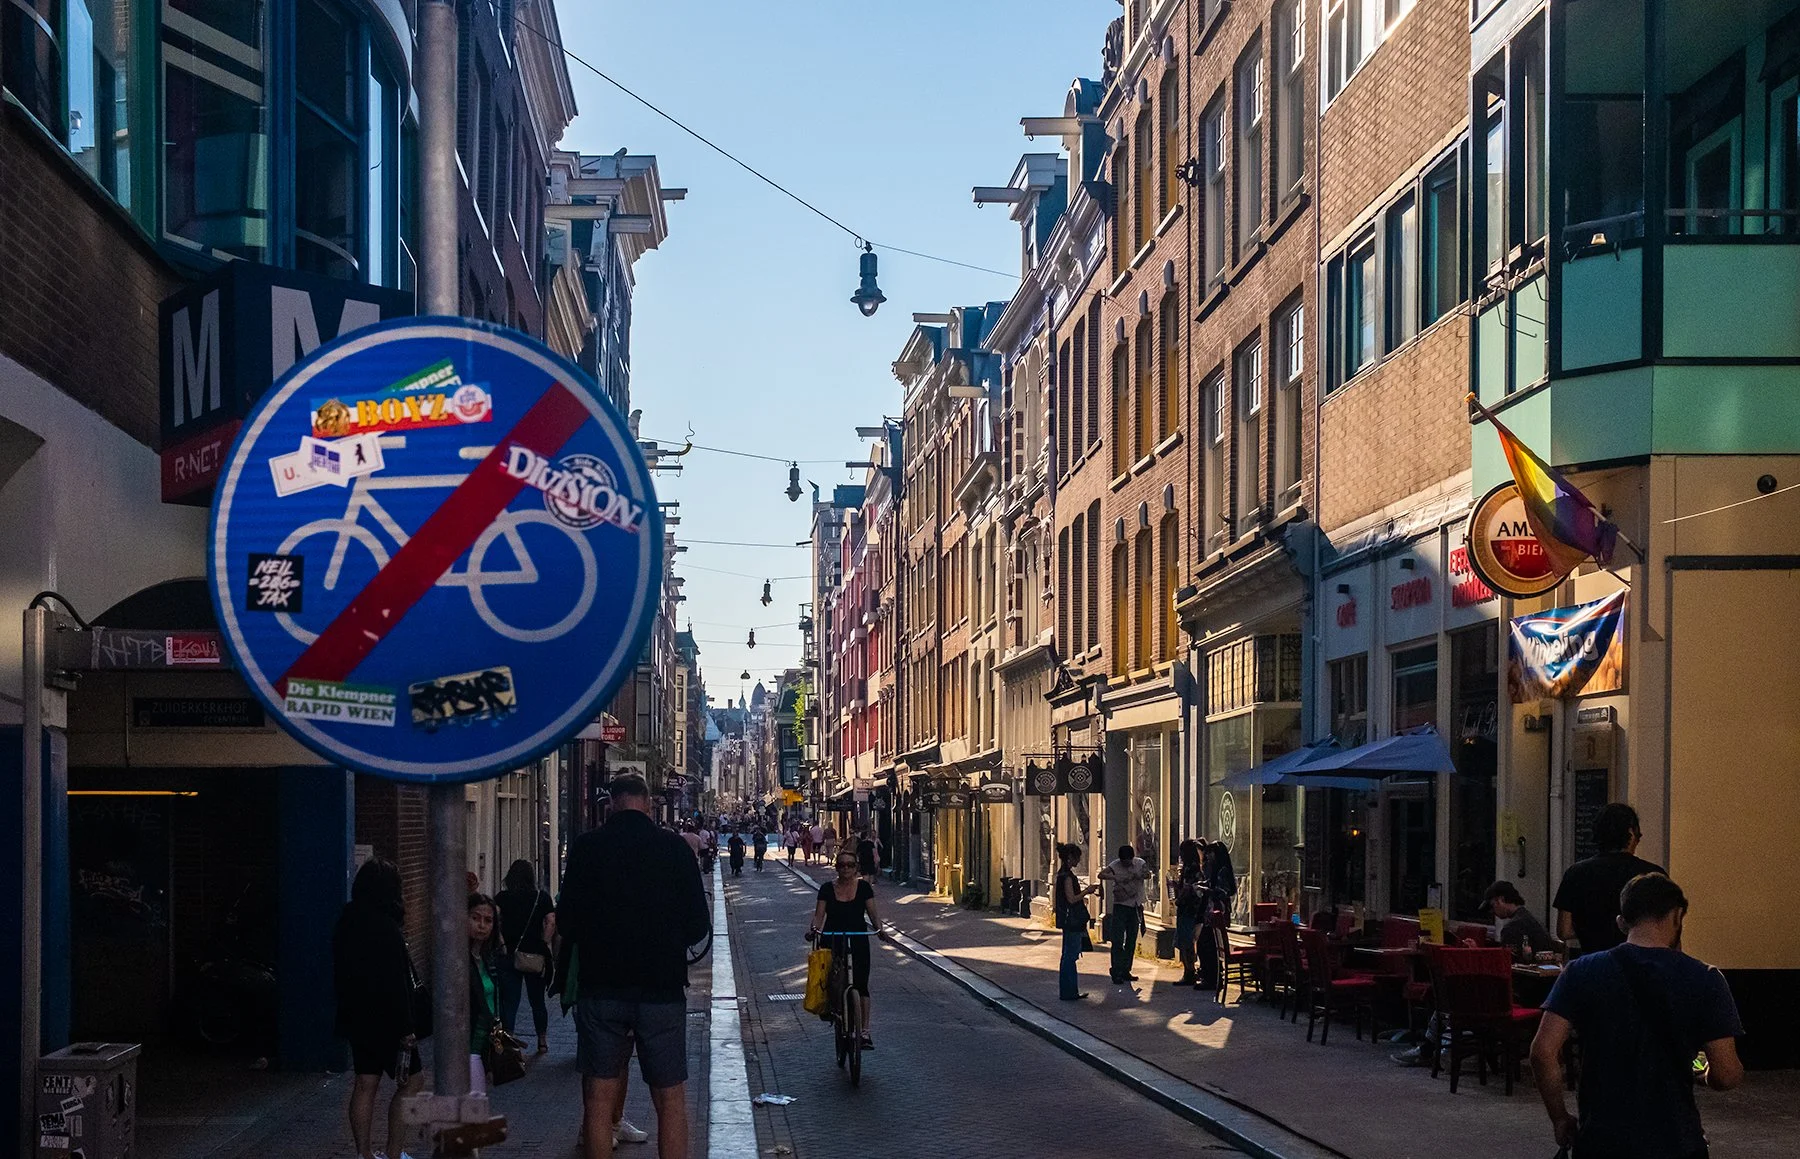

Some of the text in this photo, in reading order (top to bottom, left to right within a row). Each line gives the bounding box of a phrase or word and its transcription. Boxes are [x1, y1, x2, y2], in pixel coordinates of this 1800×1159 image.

[172, 288, 221, 428] M
[356, 393, 449, 427] BOYZ
[254, 559, 295, 576] NEIL
[256, 589, 293, 607] JAX
[1523, 631, 1600, 670] Kibbeling
[288, 682, 395, 703] Die Klempner
[151, 702, 249, 714] ZUIDERKERKHOF
[286, 700, 394, 721] RAPID WIEN
